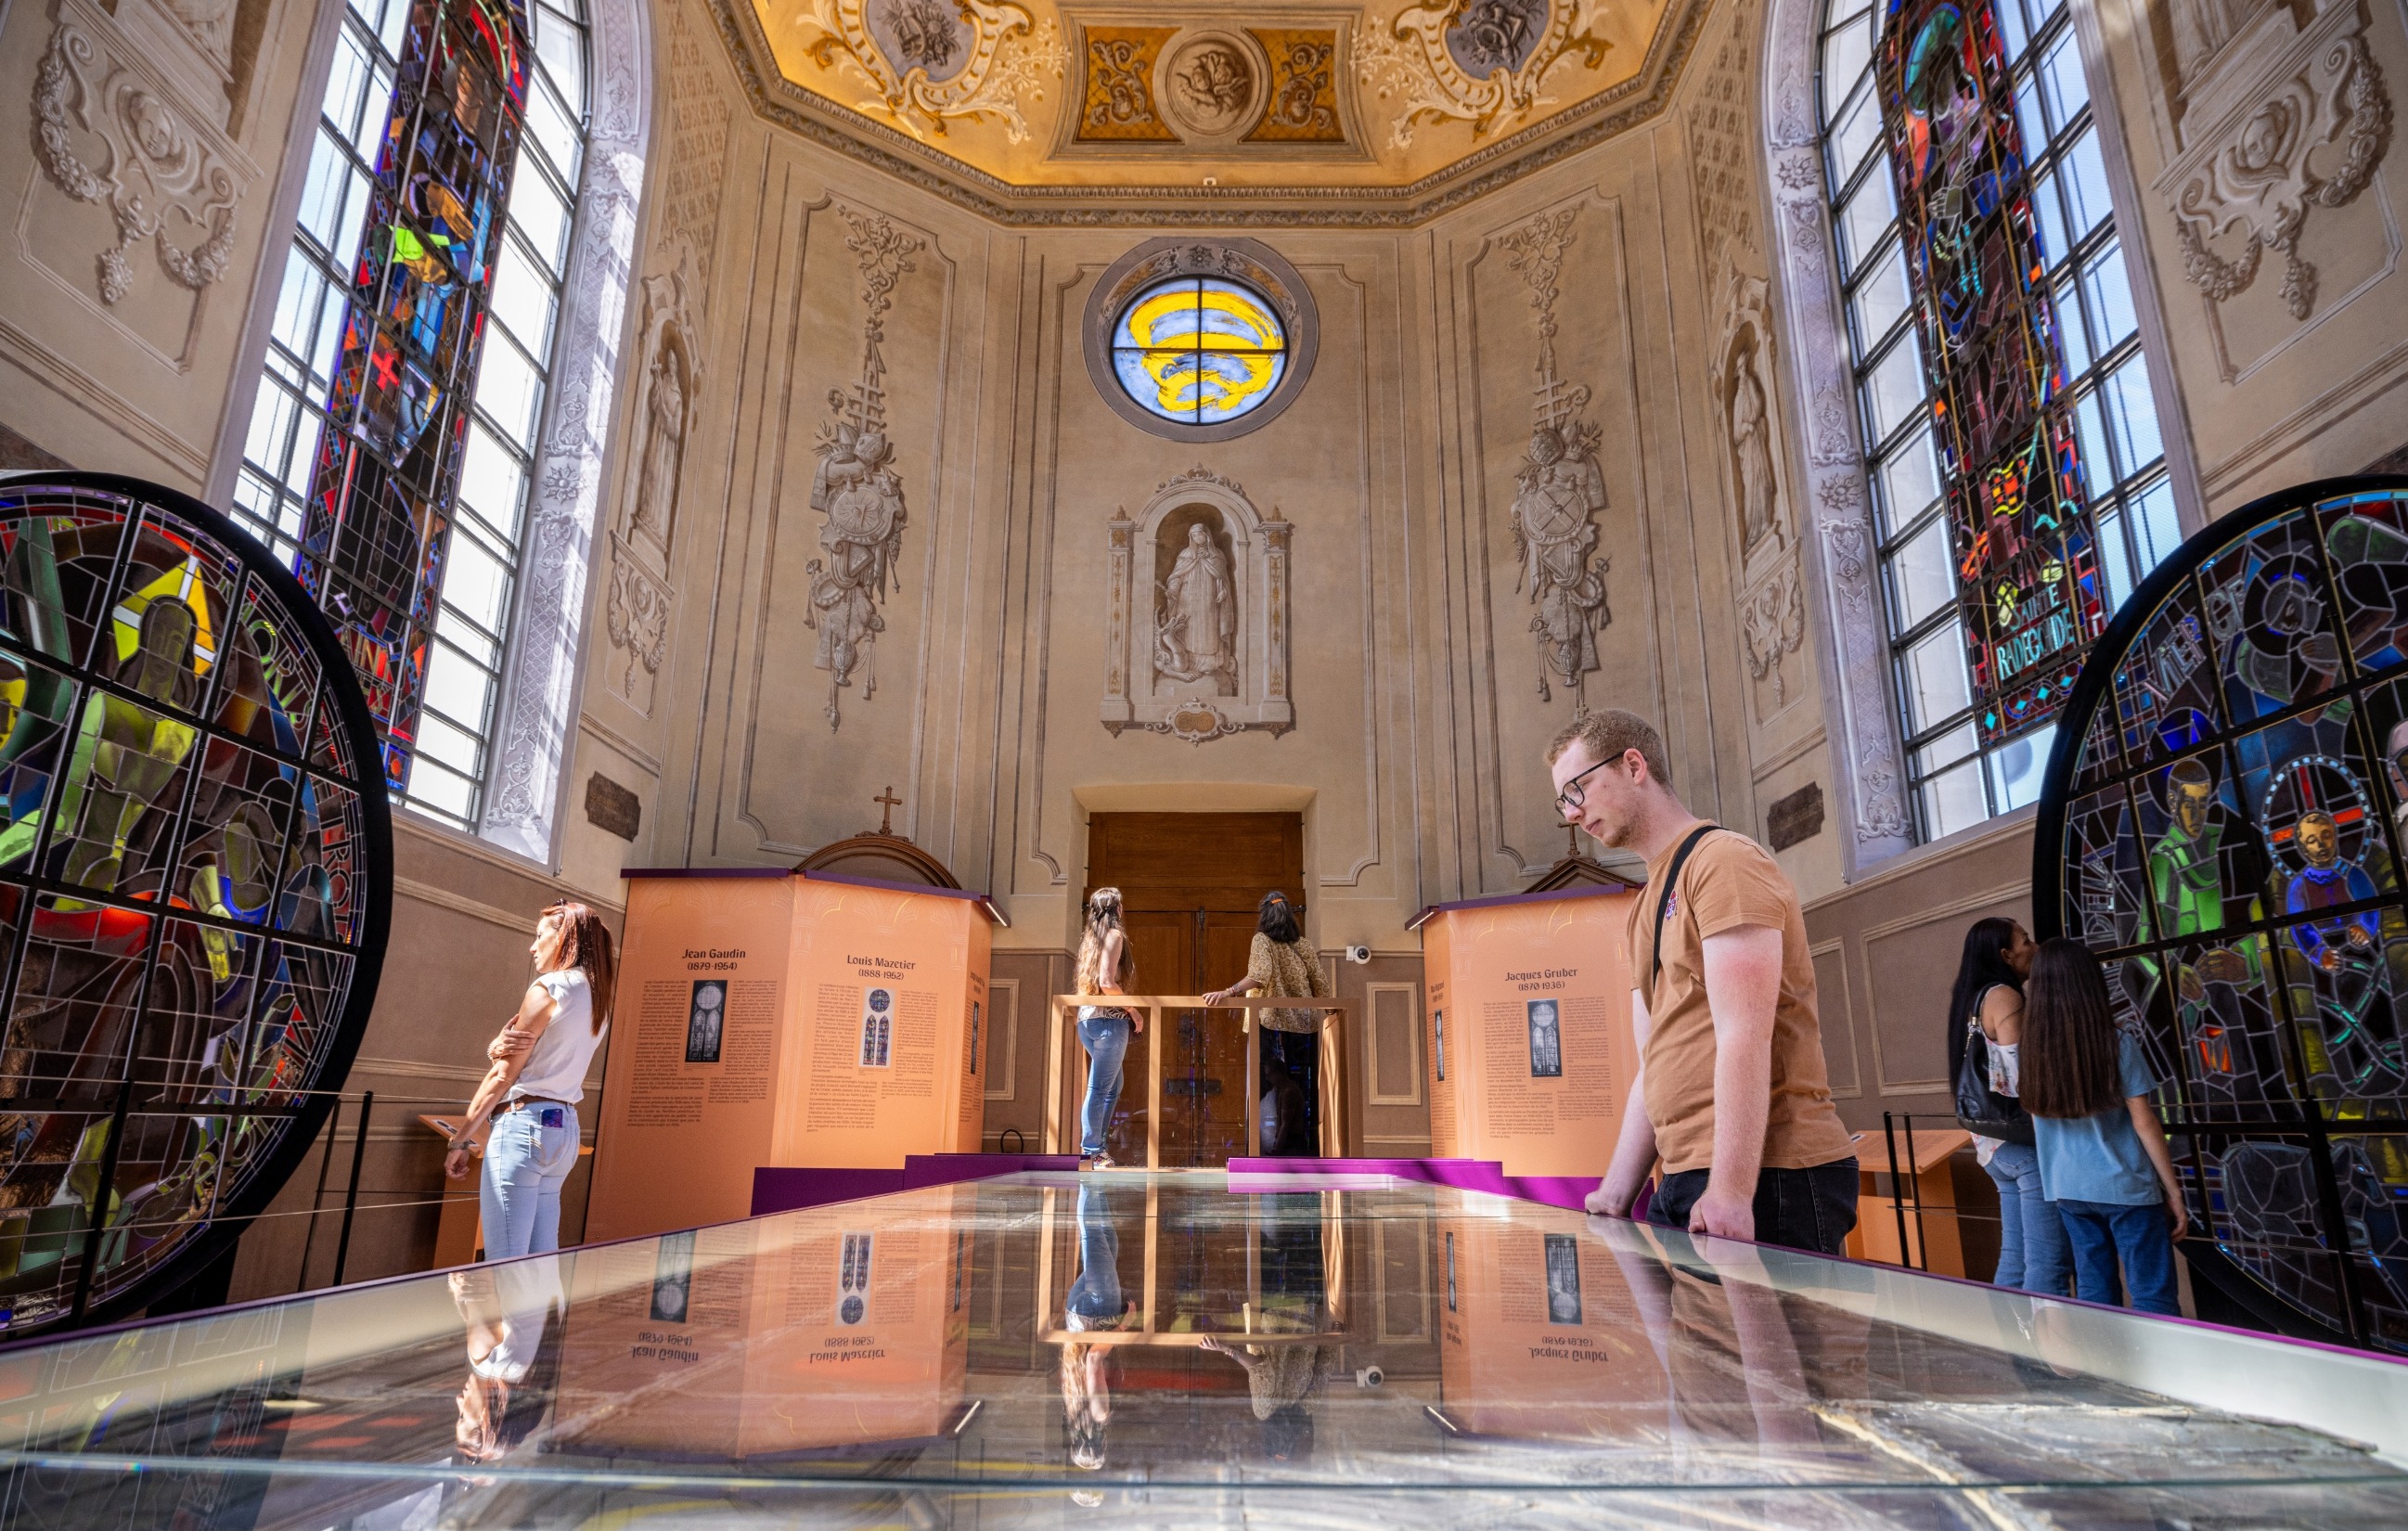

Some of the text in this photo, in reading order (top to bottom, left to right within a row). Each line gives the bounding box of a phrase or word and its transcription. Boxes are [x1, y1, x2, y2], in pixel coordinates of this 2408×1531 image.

[1996, 607, 2076, 680] RADEGONDE
[682, 948, 746, 958] Jean Gaudin
[687, 961, 738, 971] (1879-1954)
[846, 955, 916, 971] Louis Mazetier
[858, 968, 905, 980] (1888-1952)
[1505, 968, 1577, 982] Jacques Gruber
[1518, 981, 1565, 992] (1870-1936)
